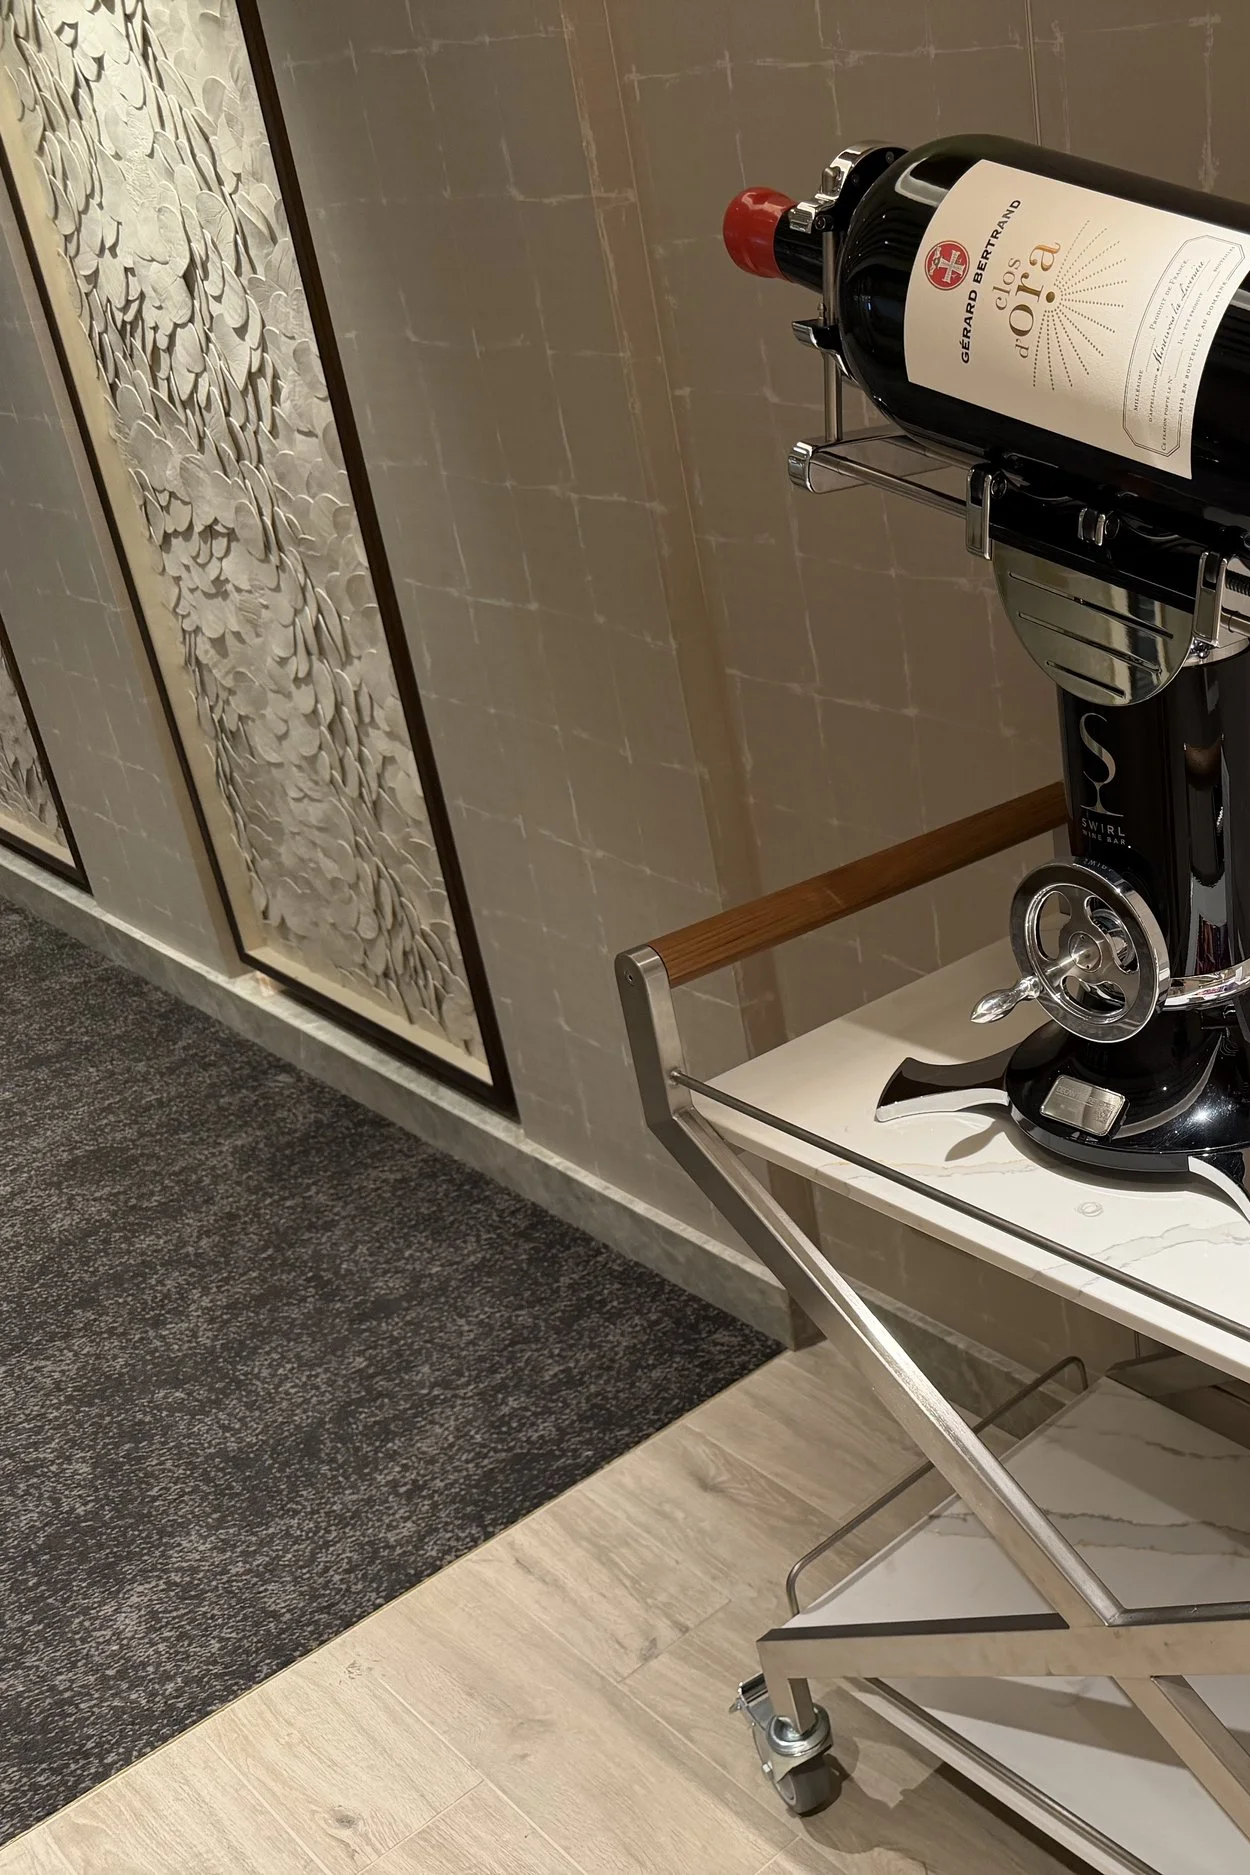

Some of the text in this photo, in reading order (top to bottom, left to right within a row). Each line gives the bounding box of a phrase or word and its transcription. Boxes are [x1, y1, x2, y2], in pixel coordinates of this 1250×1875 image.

[960, 199, 1021, 363] GÉRARD BERTRAND
[993, 257, 1021, 311] clos
[1081, 817, 1125, 837] SWIRL
[1106, 835, 1126, 846] BAR
